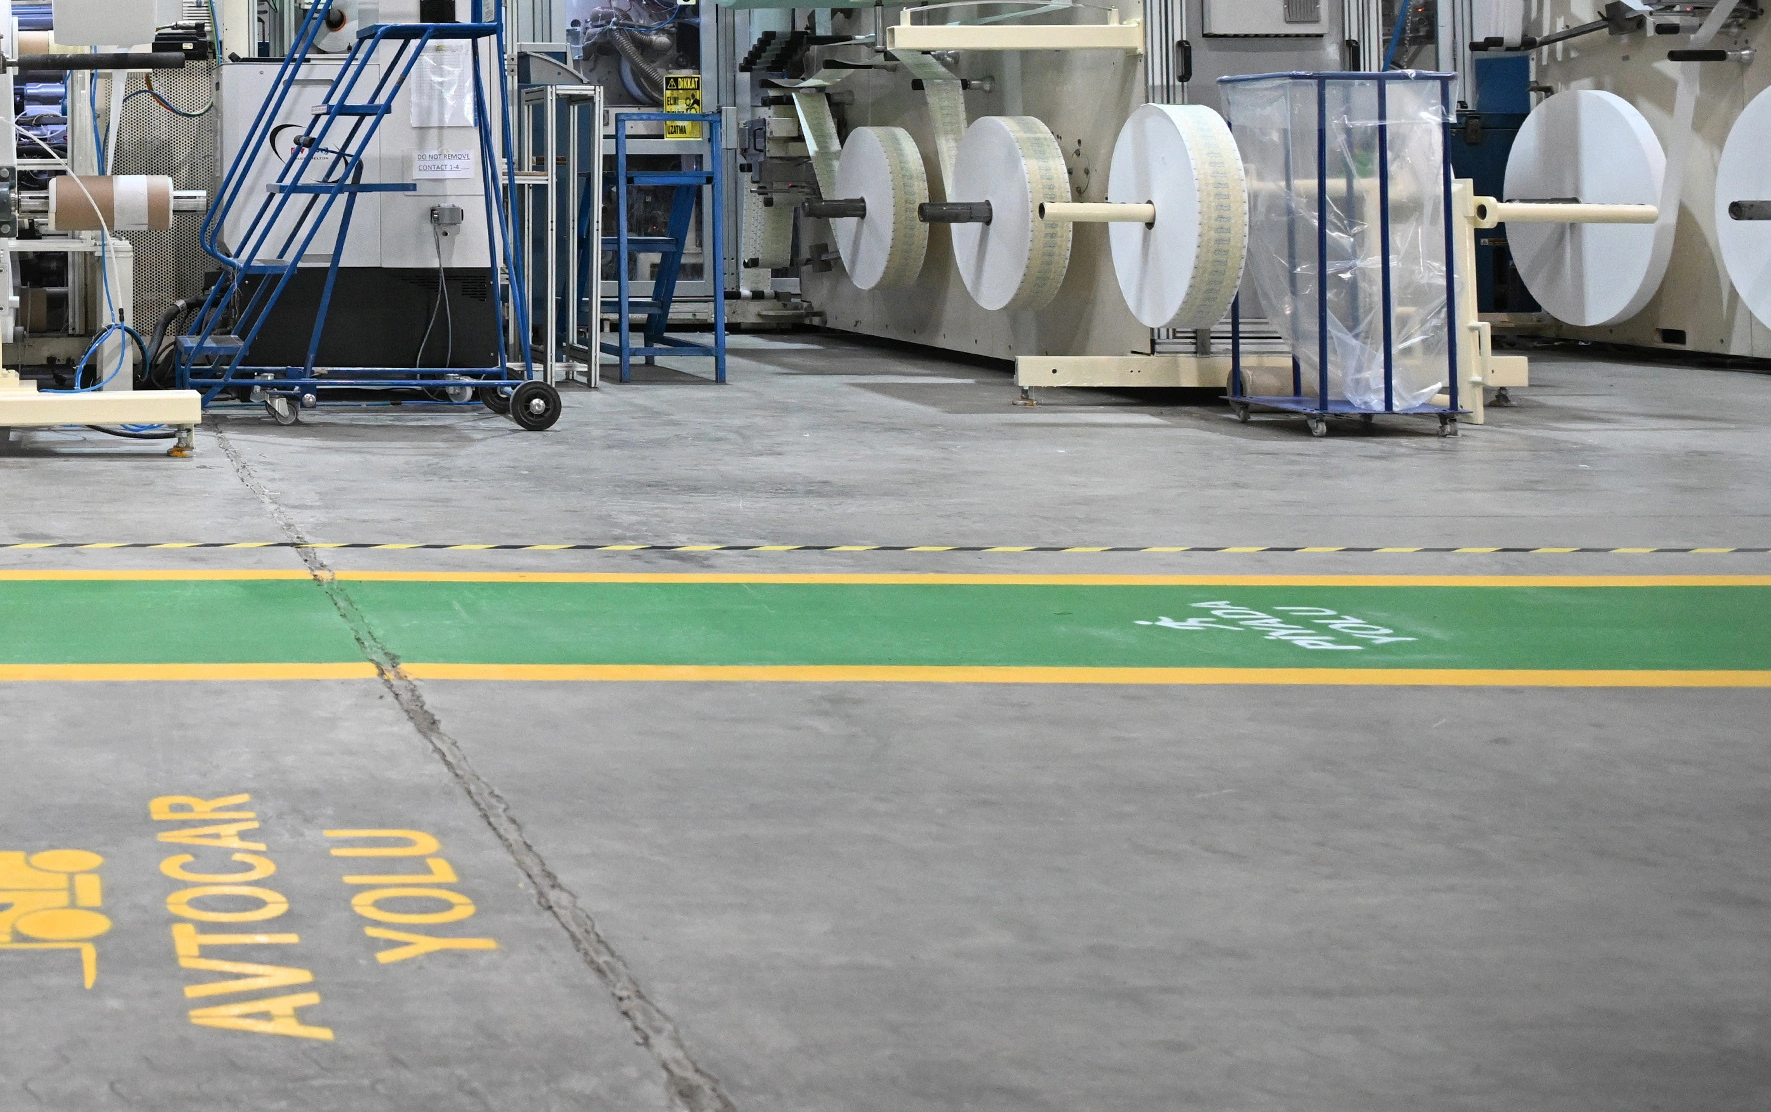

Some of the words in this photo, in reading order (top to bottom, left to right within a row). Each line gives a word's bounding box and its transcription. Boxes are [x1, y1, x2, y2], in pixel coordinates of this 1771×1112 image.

[1273, 606, 1419, 645] YOLU
[149, 792, 335, 1041] AVTOCAR
[322, 828, 502, 965] YOLU
